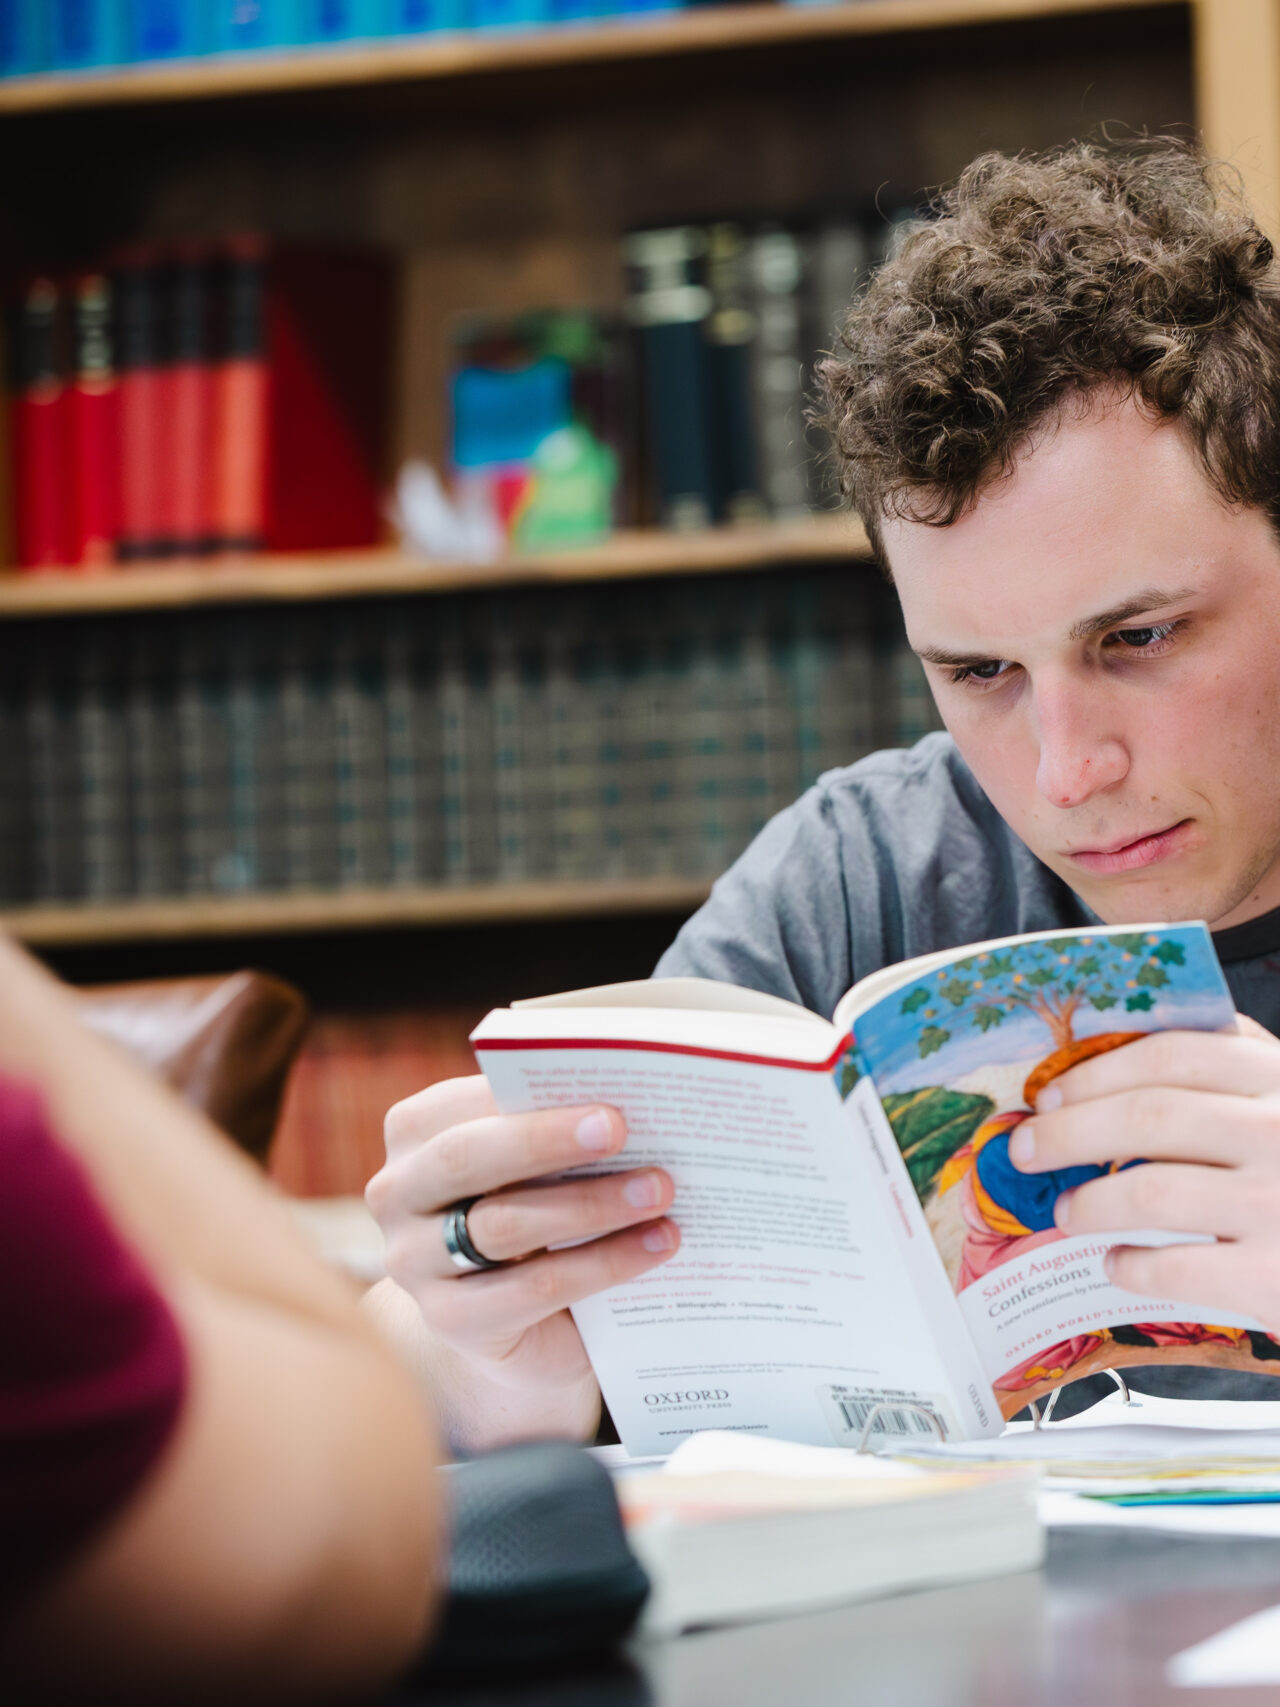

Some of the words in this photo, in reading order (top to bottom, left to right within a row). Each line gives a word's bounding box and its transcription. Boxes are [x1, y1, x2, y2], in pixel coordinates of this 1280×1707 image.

[982, 1269, 1025, 1302] Saint
[1028, 1242, 1117, 1277] Augustin
[987, 1265, 1092, 1319] Confessions
[1004, 1313, 1022, 1326] new
[1022, 1289, 1075, 1316] translation
[1075, 1285, 1088, 1297] by
[1005, 1327, 1053, 1359] OXFORD
[1056, 1308, 1114, 1330] WORLD'S
[1118, 1303, 1175, 1314] CLASSICS
[644, 1388, 730, 1407] OXFORD
[648, 1404, 703, 1414] UNIVERSITY
[706, 1401, 733, 1410] PRESS
[967, 1383, 990, 1429] OXFORD
